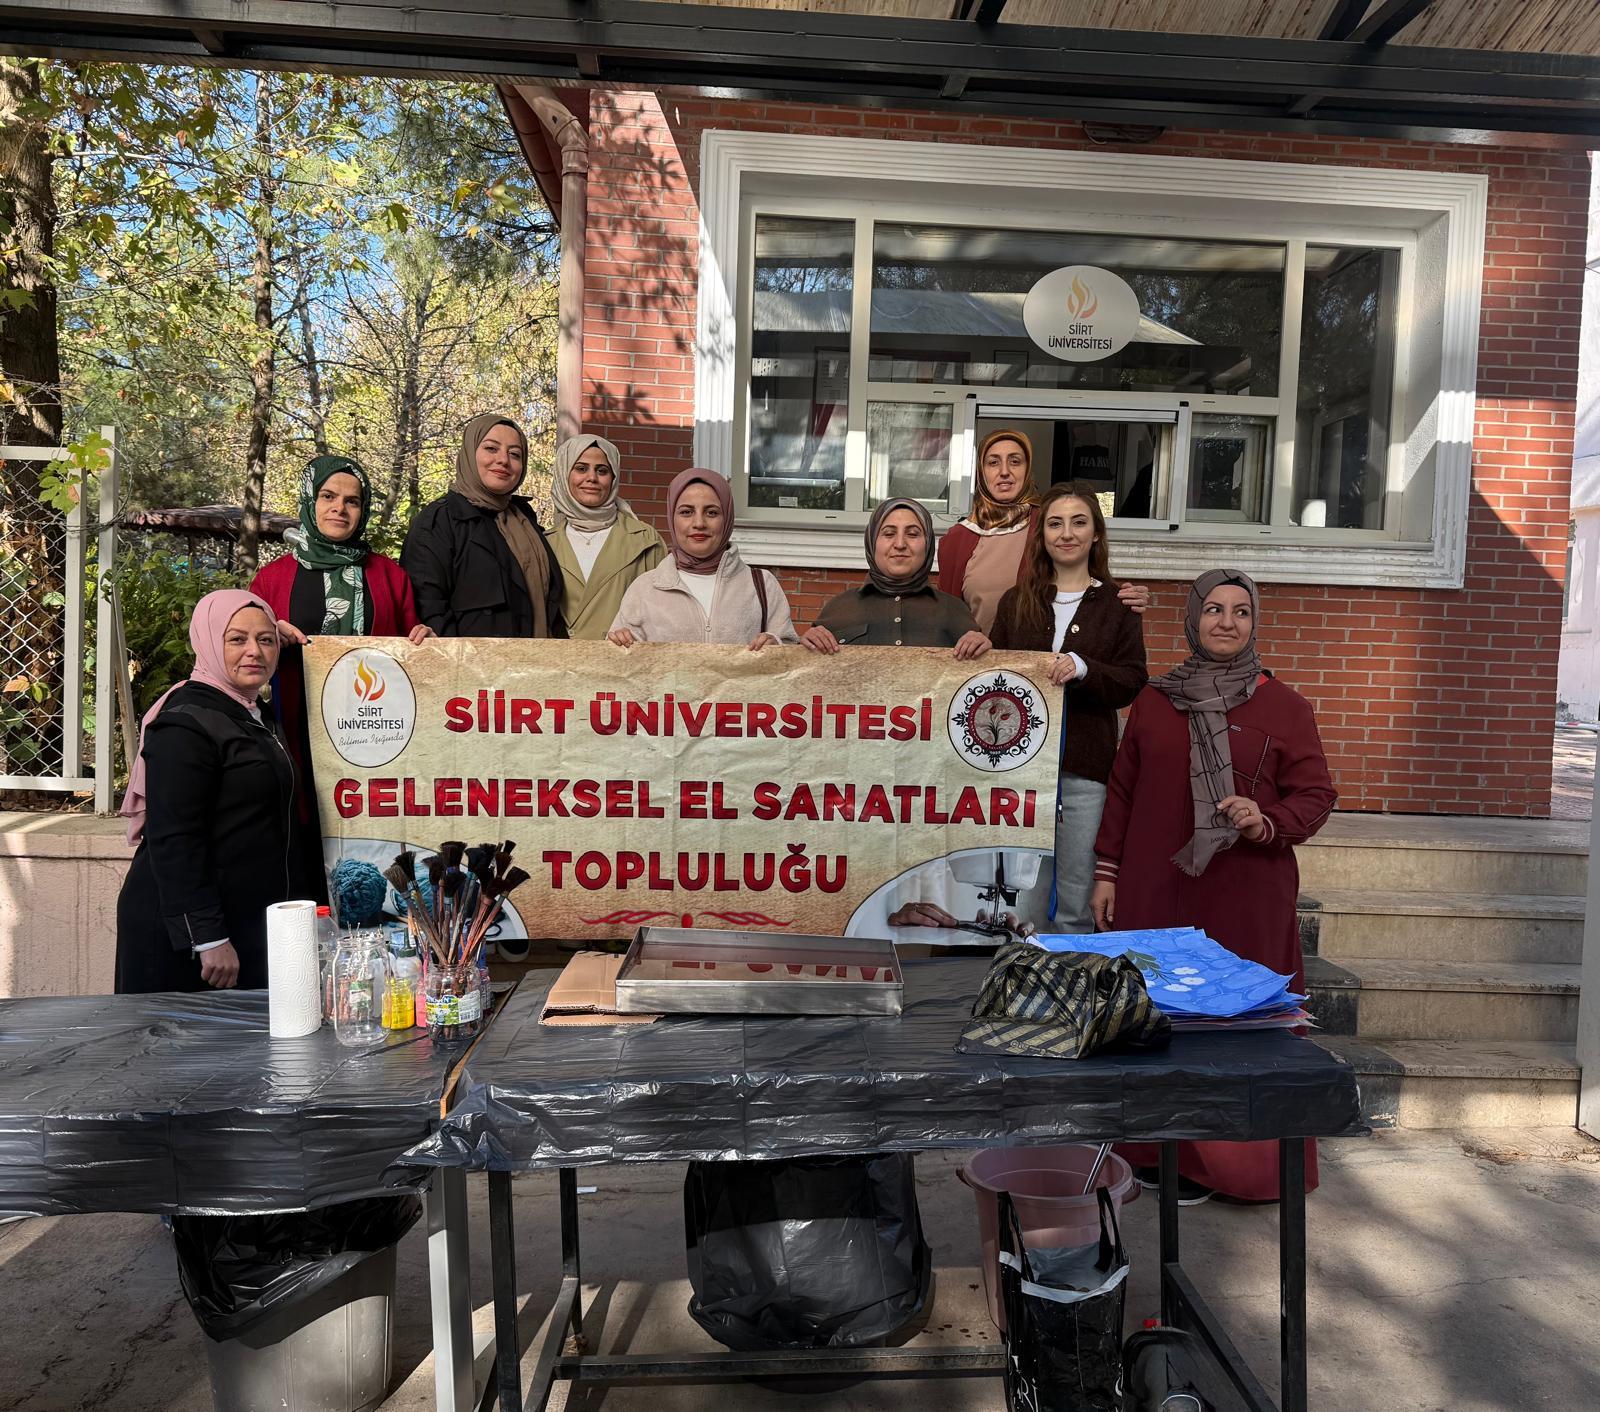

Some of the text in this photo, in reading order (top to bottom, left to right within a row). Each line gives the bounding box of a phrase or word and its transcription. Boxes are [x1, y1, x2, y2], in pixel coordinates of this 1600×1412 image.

[1068, 323, 1094, 336] SİİRT
[1048, 335, 1113, 350] ÜNİVERSİTESİ
[357, 705, 383, 717] SİİRT
[444, 689, 575, 734] SİİRT
[589, 691, 933, 741] ÜNİVERSİTESİ
[337, 717, 404, 730] ÜNİVERSİTESİ
[333, 777, 1037, 828] GELENEKSEL EL SANATLARI
[542, 843, 848, 893] TOPLULUĞU
